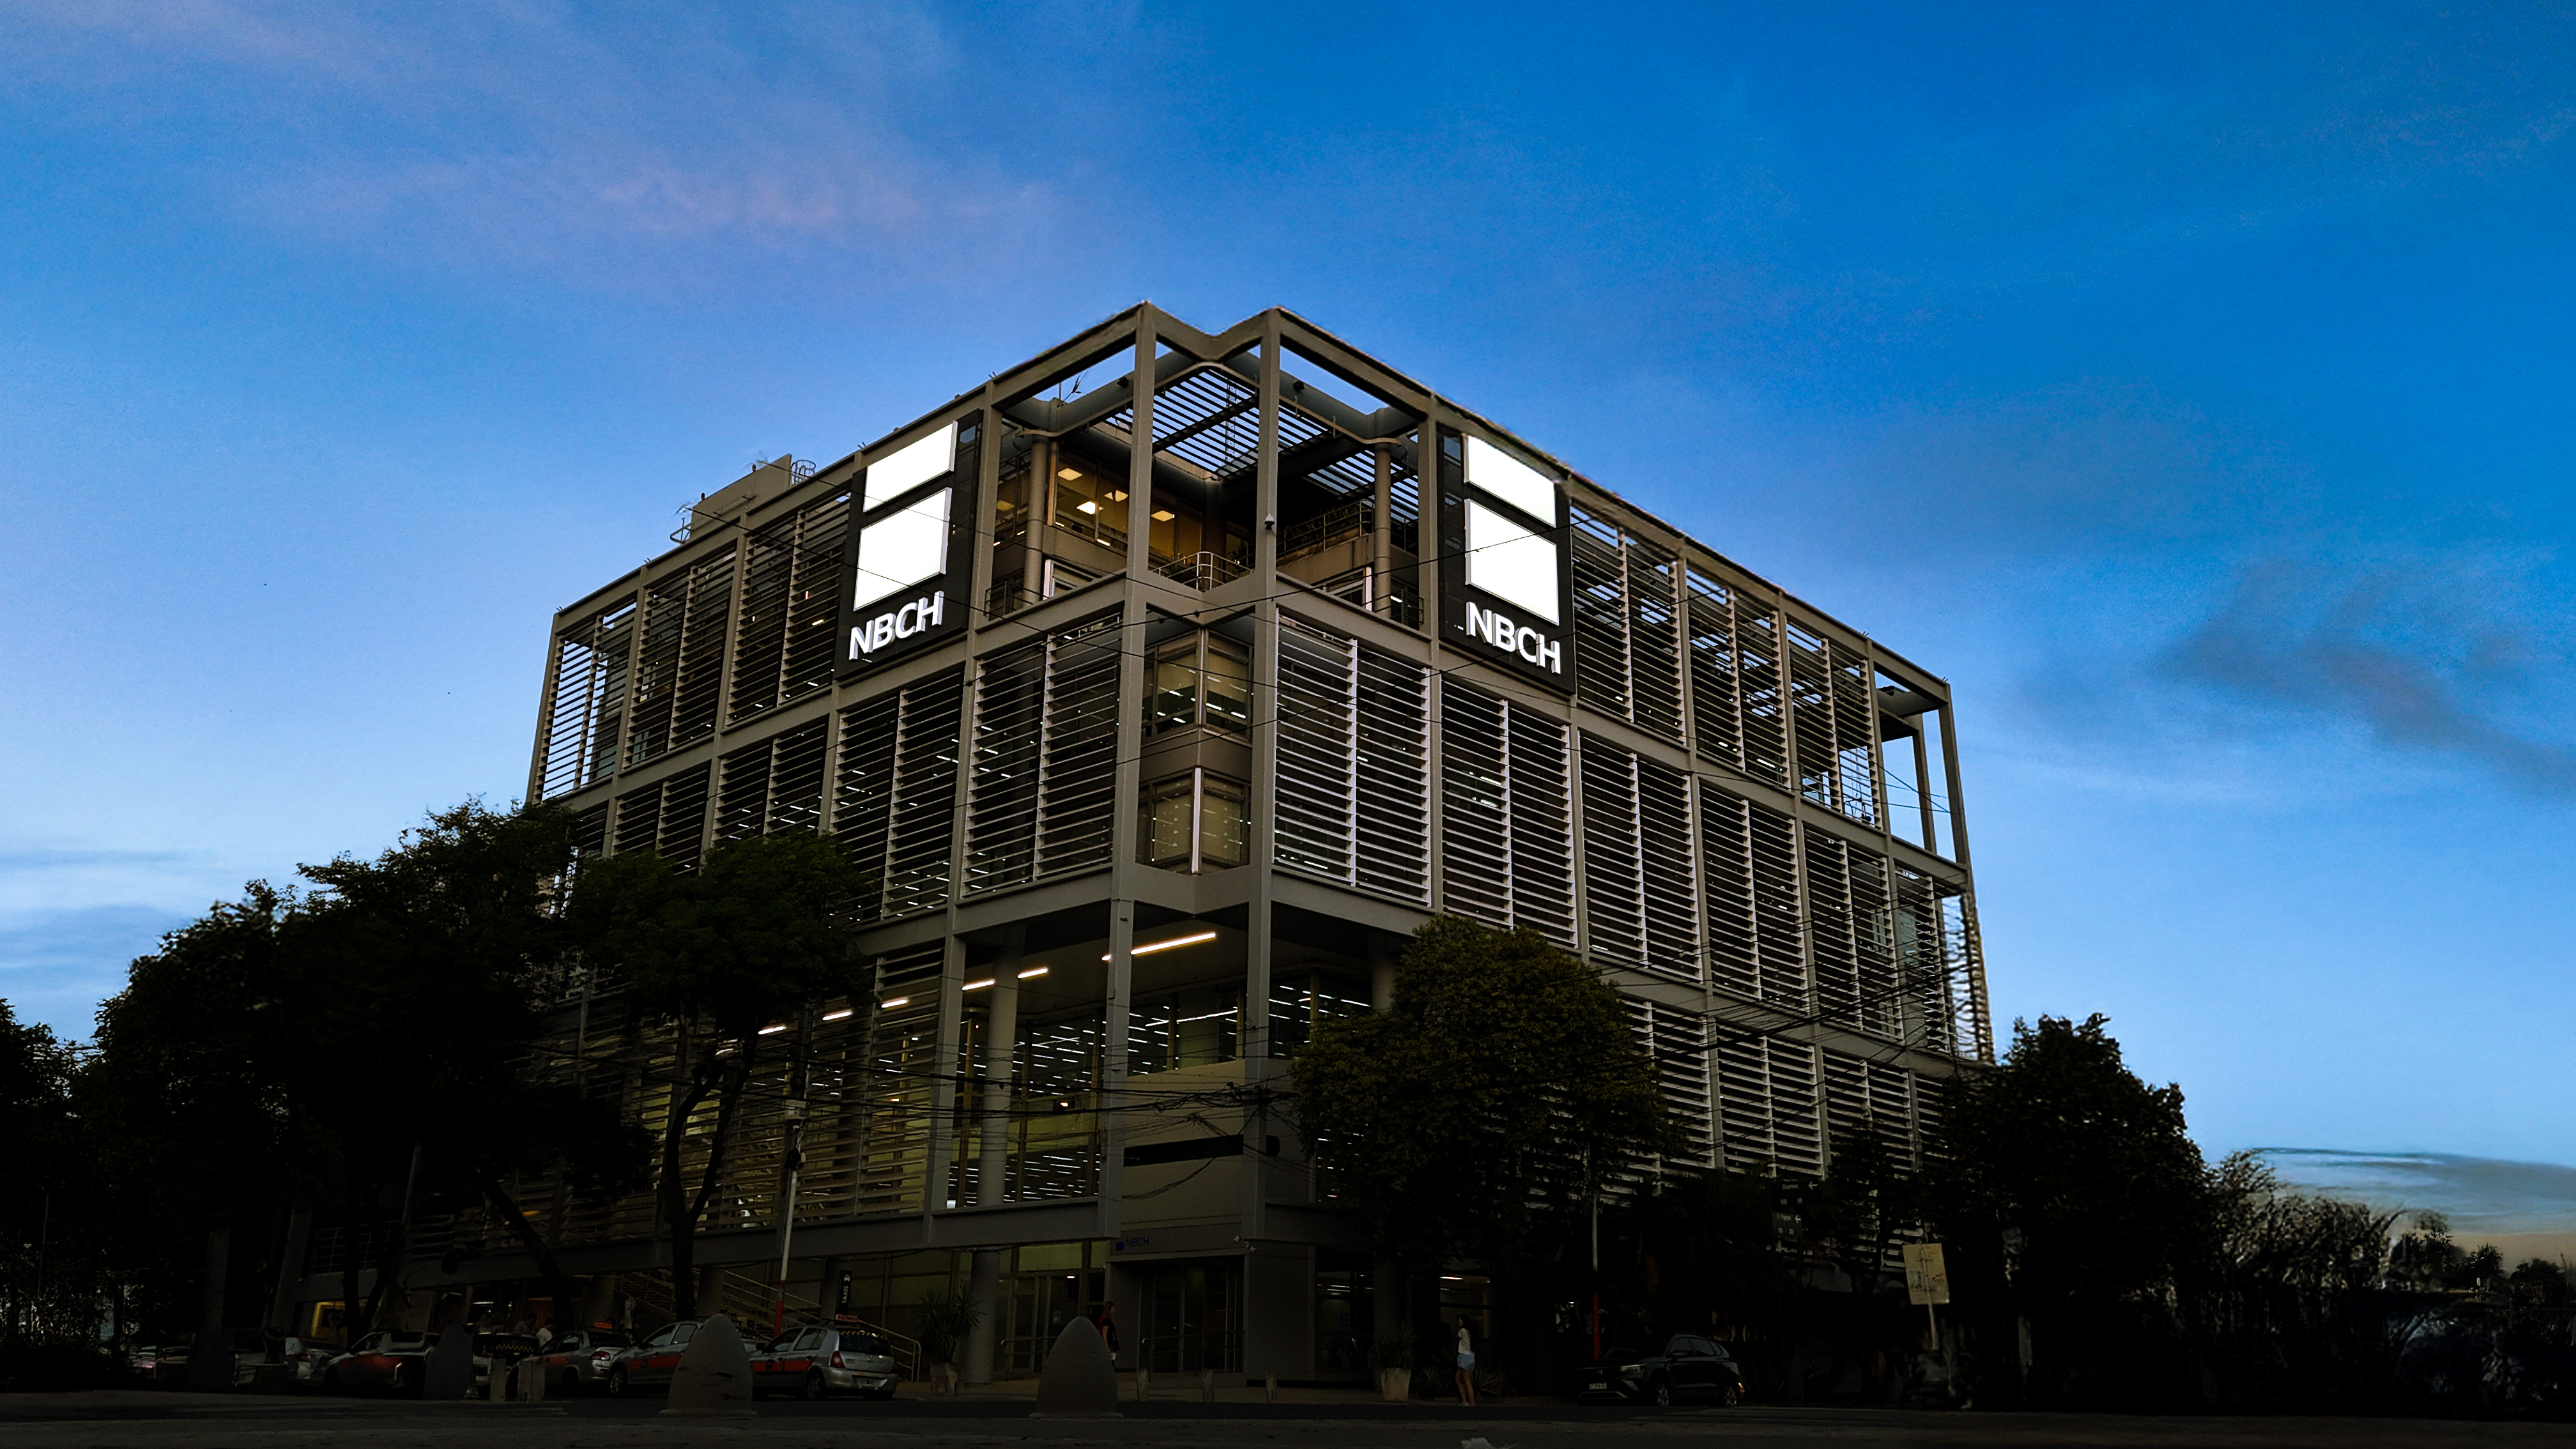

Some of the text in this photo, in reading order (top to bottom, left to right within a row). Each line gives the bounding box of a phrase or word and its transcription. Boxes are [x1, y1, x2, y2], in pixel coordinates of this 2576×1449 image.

[848, 590, 944, 661] NBCH
[1466, 601, 1561, 675] NBCH
[1125, 1236, 1150, 1247] NBCH
